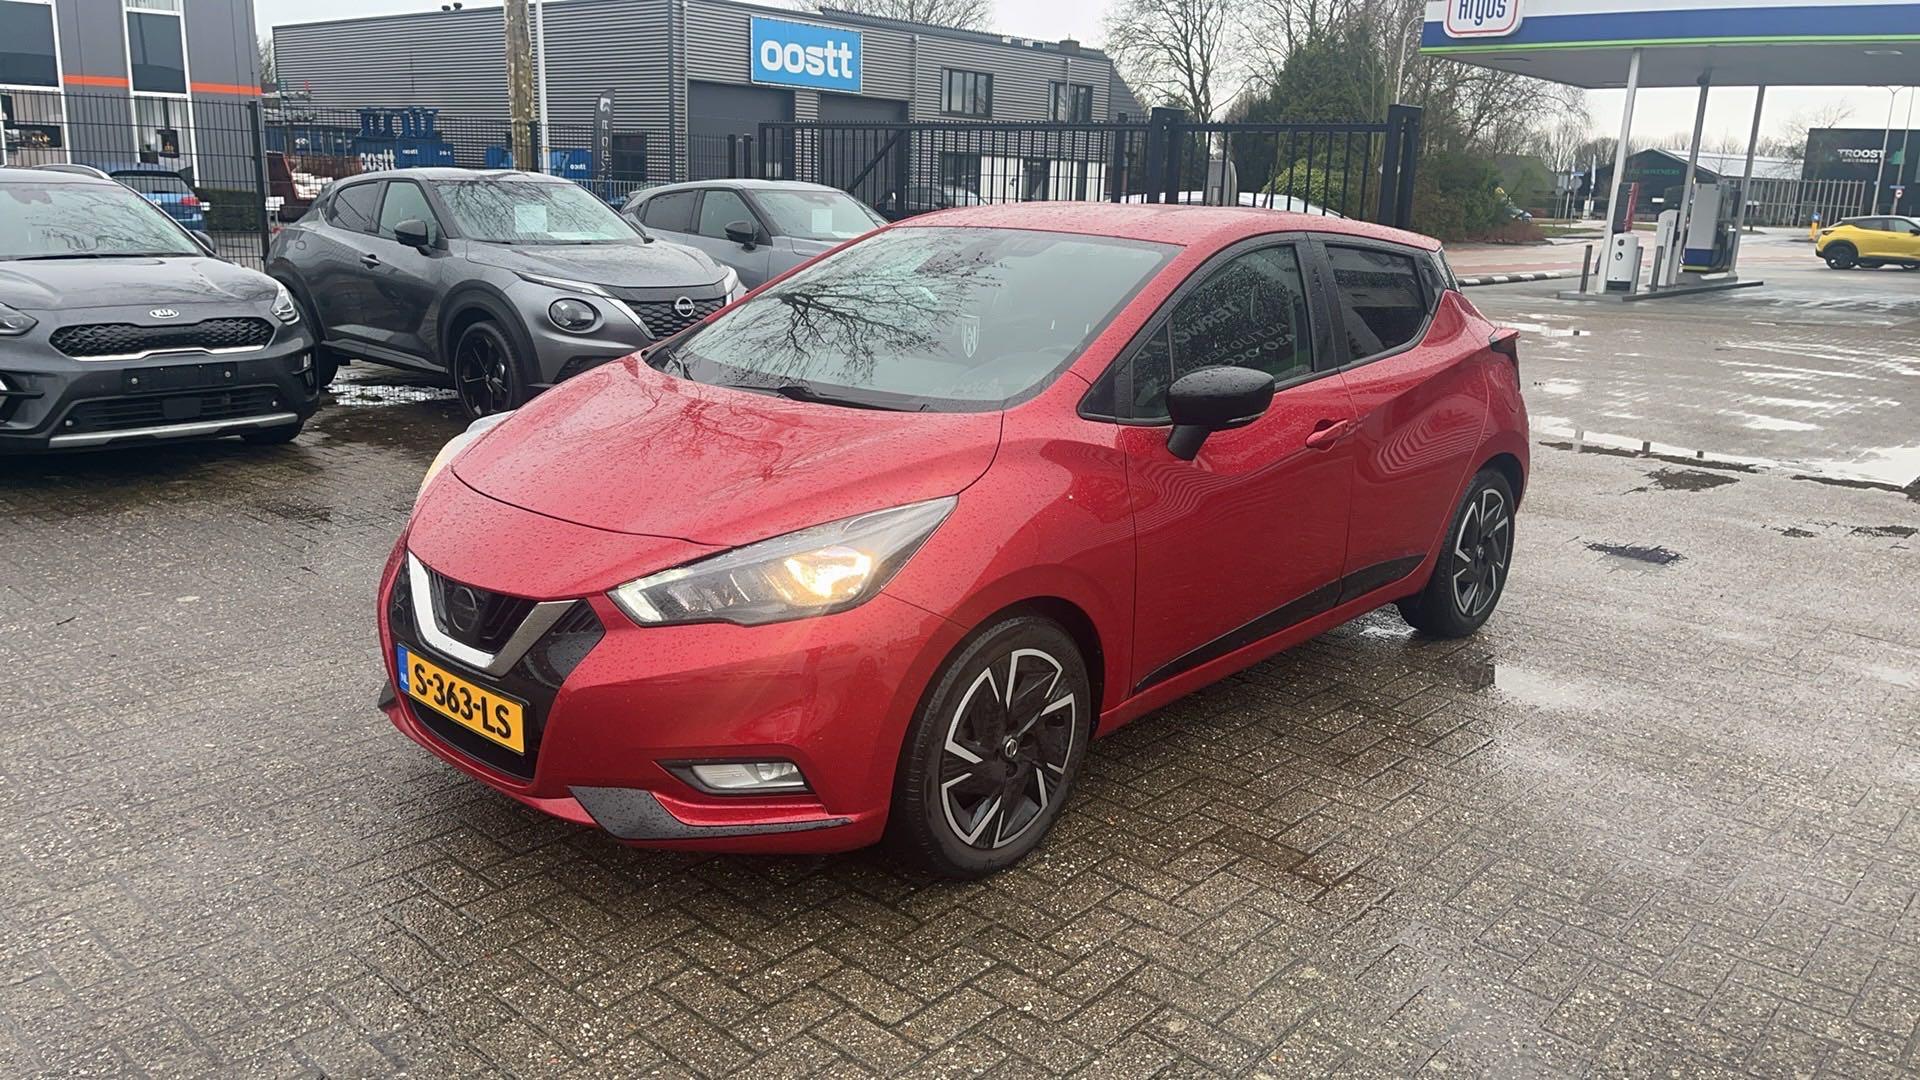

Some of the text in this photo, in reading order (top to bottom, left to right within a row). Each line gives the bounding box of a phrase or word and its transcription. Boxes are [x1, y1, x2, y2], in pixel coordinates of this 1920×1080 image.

[761, 40, 853, 79] oostt
[1837, 149, 1886, 159] TROOST
[414, 663, 512, 739] S-363-LS
